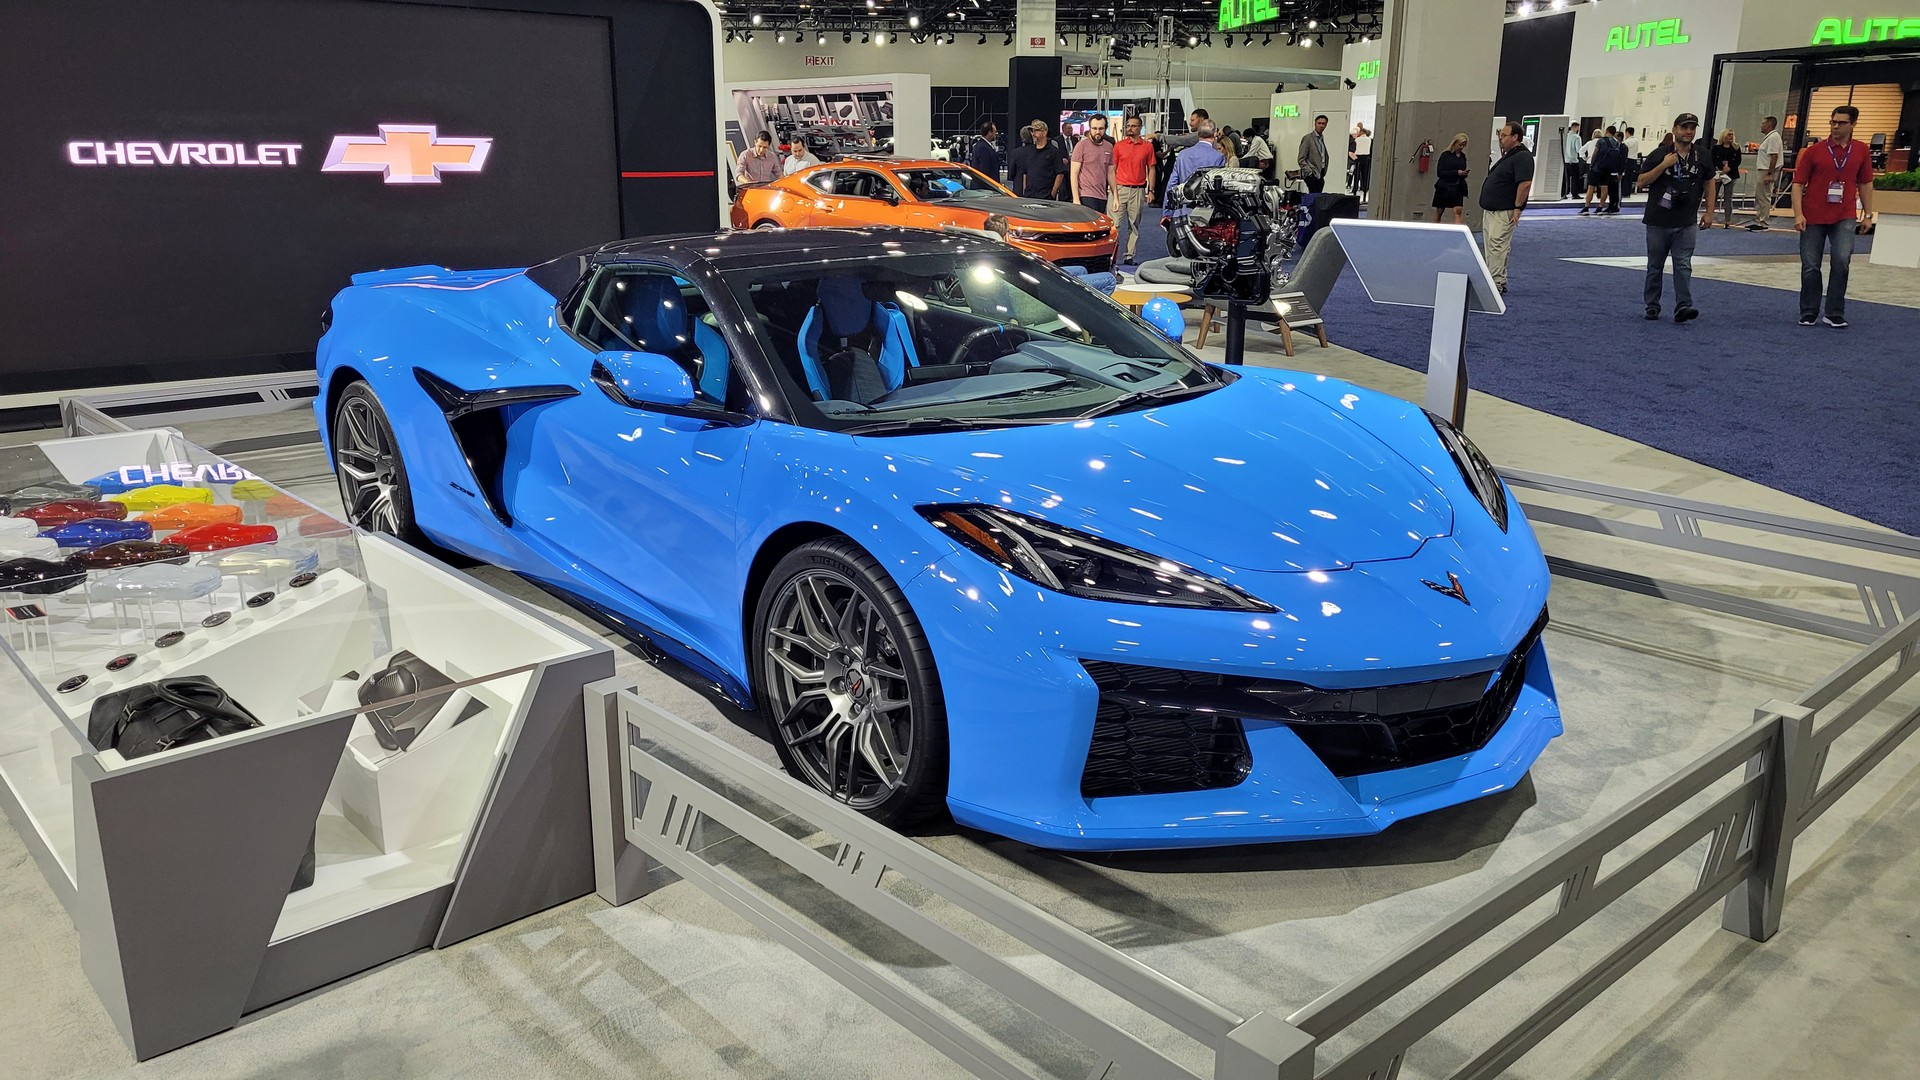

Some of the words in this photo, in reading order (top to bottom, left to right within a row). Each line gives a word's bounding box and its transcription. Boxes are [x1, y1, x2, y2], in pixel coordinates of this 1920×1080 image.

[1604, 18, 1689, 52] AUTEL
[815, 56, 835, 66] EXIT
[1273, 104, 1300, 118] AUTEL
[68, 142, 302, 165] CHEVROLET
[814, 555, 857, 579] MICHELIN
